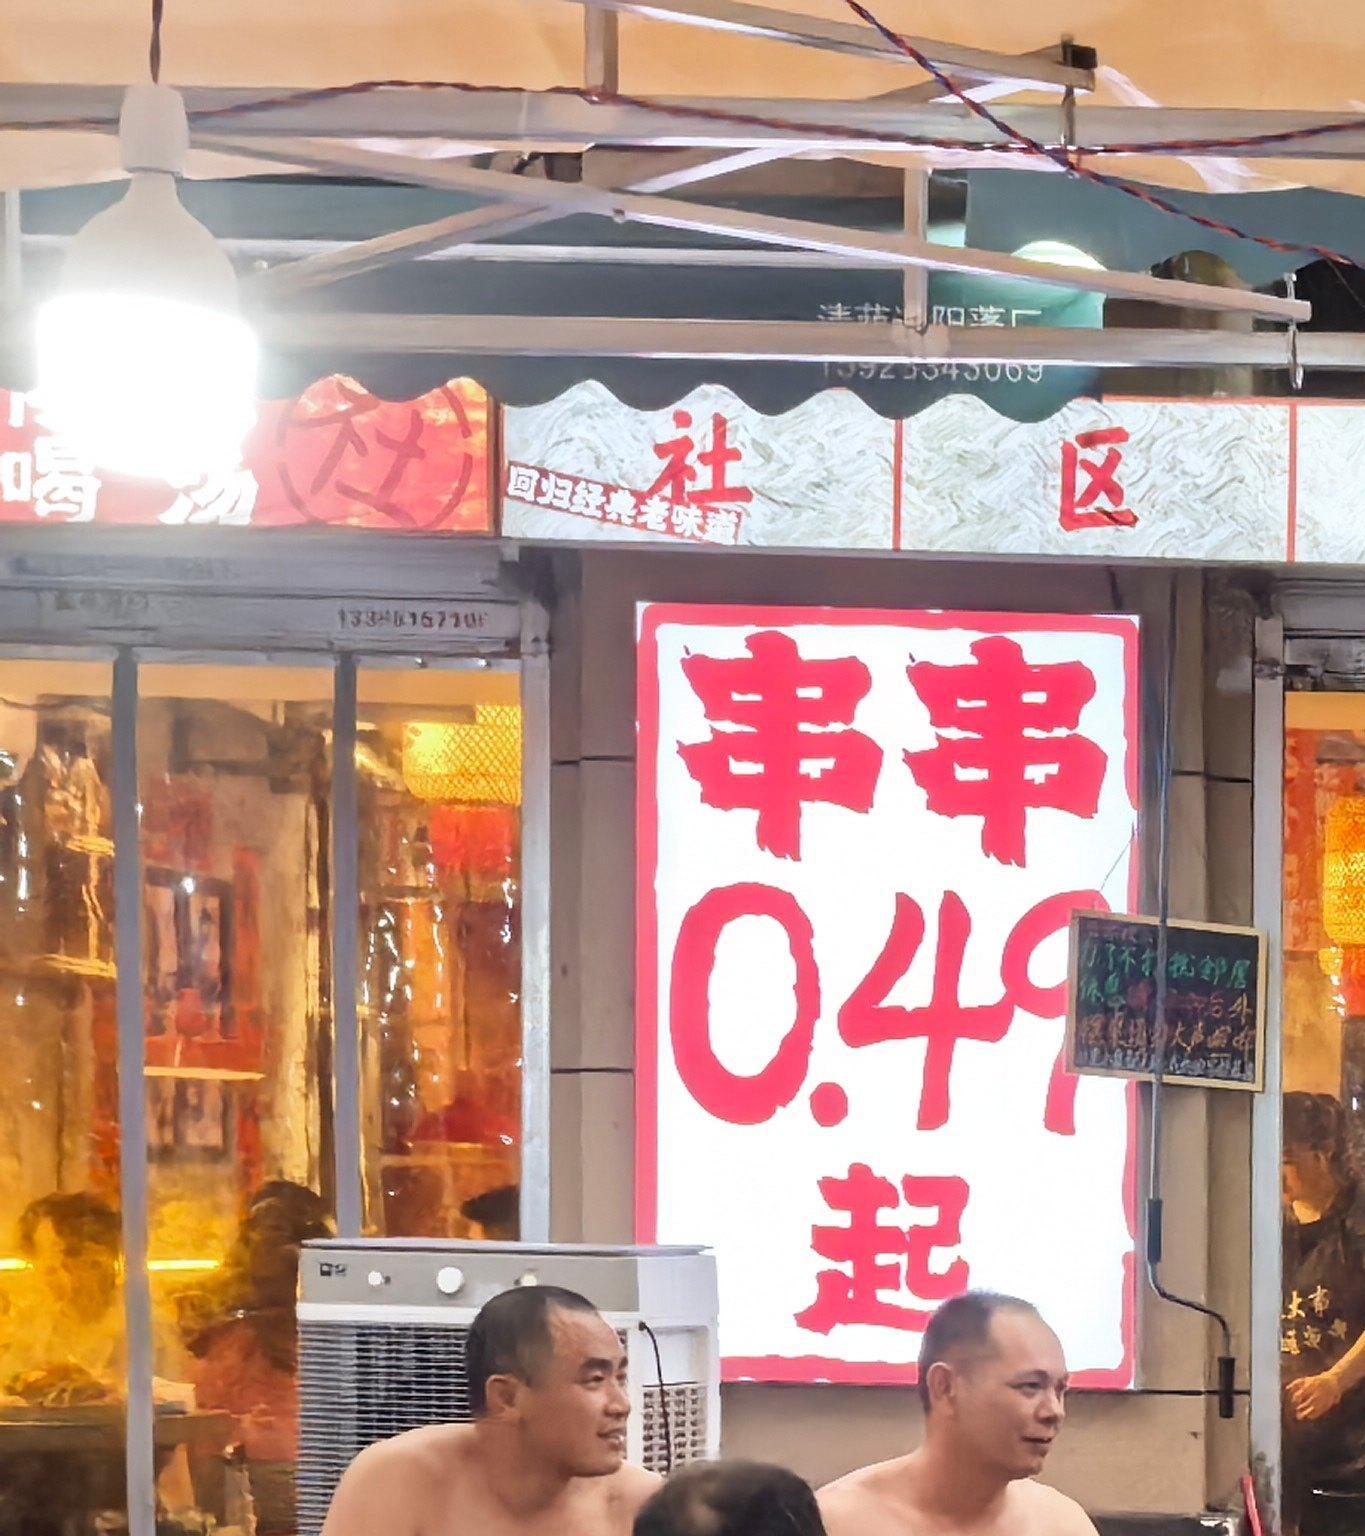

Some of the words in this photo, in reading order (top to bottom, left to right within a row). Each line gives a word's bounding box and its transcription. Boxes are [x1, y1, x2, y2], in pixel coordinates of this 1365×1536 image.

[676, 630, 1109, 868] 串串
[669, 881, 1113, 1136] 0.49
[793, 1162, 971, 1335] 起
